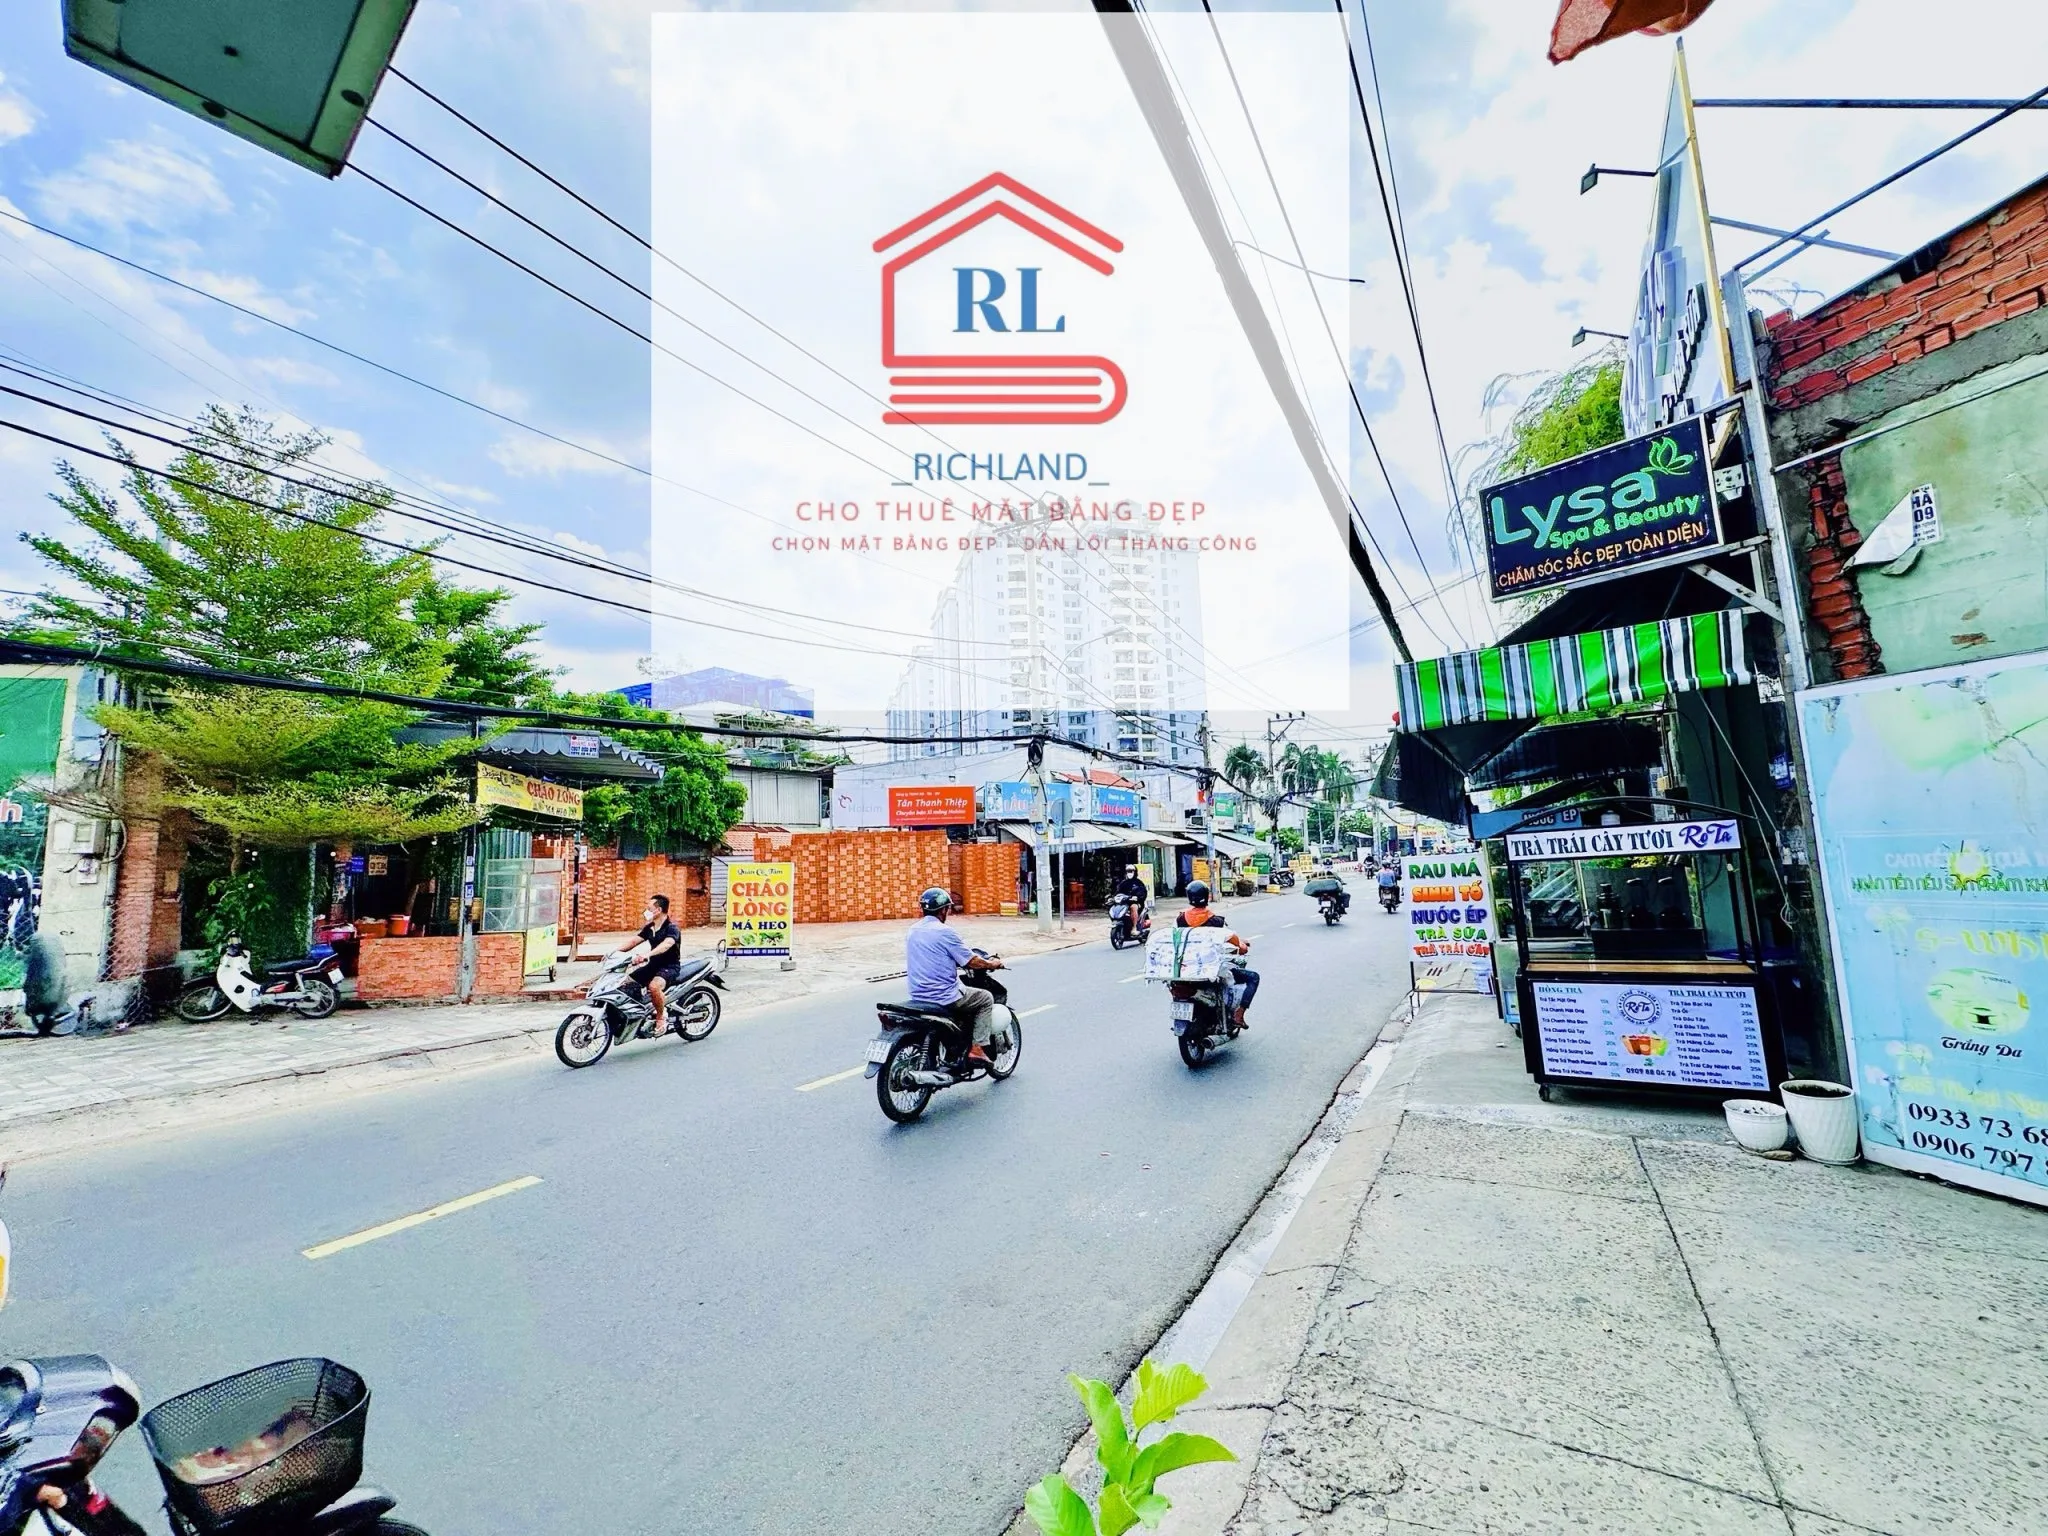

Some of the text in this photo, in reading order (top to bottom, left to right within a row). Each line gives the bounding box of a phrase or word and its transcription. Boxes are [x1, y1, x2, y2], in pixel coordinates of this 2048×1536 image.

[1490, 471, 1658, 549] Lysa
[1549, 494, 1701, 550] Spa & Beauty
[1498, 521, 1705, 588] CHĂM SÓC SẮC ĐẸP TOÀN DIỆN
[915, 797, 942, 807] Thanh
[945, 797, 968, 809] Thiệp
[1511, 831, 1545, 857] TRÀ
[1546, 832, 1588, 855] TRÁI
[1591, 830, 1624, 853] CÂY
[1627, 829, 1675, 850] TƯƠI
[1408, 857, 1483, 879] RAU MÁ
[731, 878, 789, 897] CHÁO
[1411, 880, 1484, 903] SINH TỐ
[732, 897, 788, 917] LÒNG
[1411, 905, 1488, 925] NƯỚC ÉP
[731, 918, 788, 931] MÁ HEO
[1415, 926, 1488, 941] TRÀ SỮA
[1439, 943, 1464, 955] TRÁI
[1668, 989, 1747, 999] TRÀ TRÁI CÂY TƯƠI
[1995, 1043, 2023, 1059] Da
[1626, 1067, 1644, 1075] 0909
[1908, 1102, 1971, 1130] 0933
[1979, 1116, 2013, 1139] 73
[1912, 1131, 1975, 1160] 0906
[1984, 1146, 2034, 1173] 797
